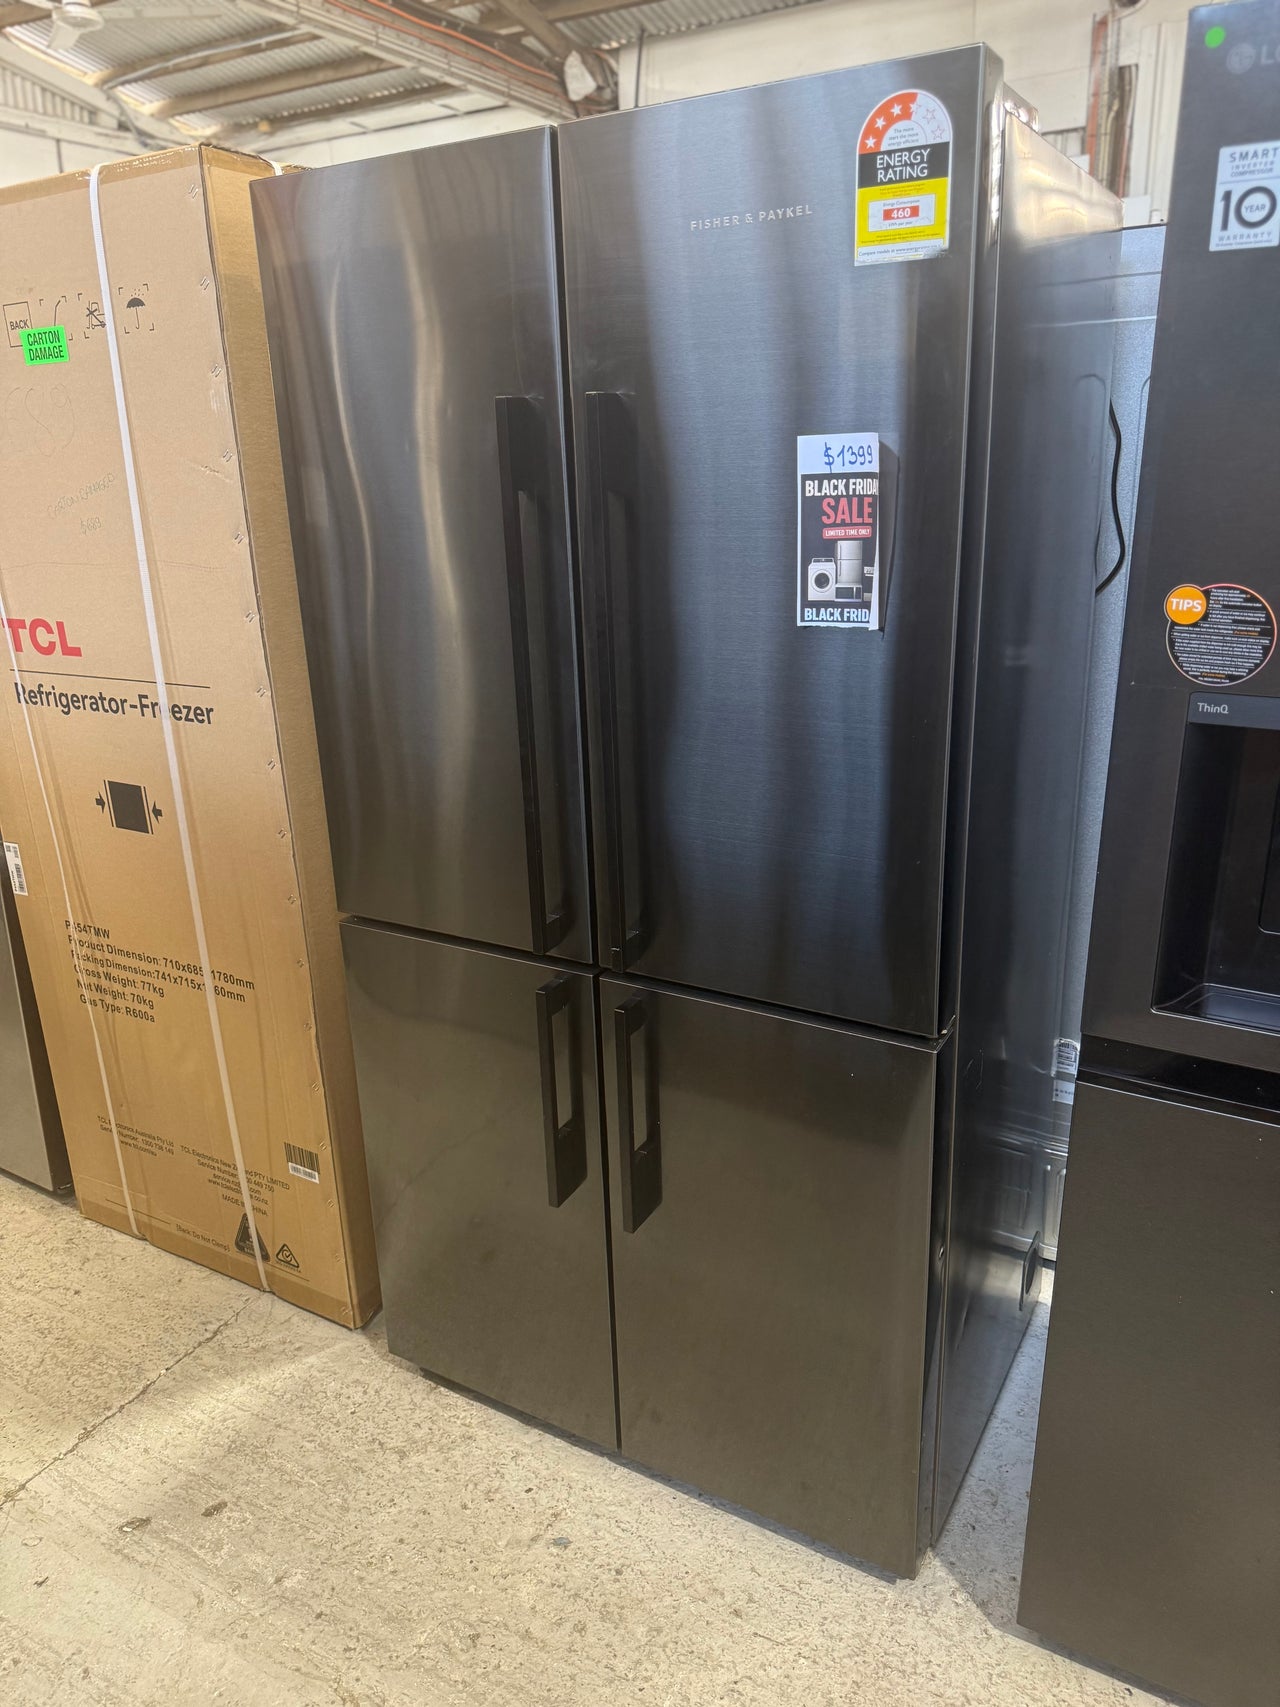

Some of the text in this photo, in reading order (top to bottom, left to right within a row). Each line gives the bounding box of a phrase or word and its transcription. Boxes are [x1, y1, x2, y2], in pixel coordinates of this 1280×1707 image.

[876, 148, 930, 169] ENERGY
[1229, 147, 1279, 164] SMART
[877, 163, 928, 184] RATING
[891, 208, 911, 219] 460
[1220, 186, 1277, 232] 10
[1244, 204, 1266, 214] YEAR
[690, 205, 813, 232] FISHER & PAYKEL
[1218, 231, 1272, 243] WARRANTY
[9, 319, 29, 330] BACK
[27, 330, 61, 347] CARTON
[28, 345, 65, 361] DAMAGE
[823, 442, 873, 473] $1399
[805, 478, 879, 497] BLACK FRIDA
[821, 497, 873, 525] SALE
[825, 529, 845, 537] LIMITED
[858, 528, 870, 536] ONLY
[1171, 598, 1202, 612] TIPS
[804, 608, 871, 622] BLACK FRID
[1, 617, 82, 657] TCL
[14, 682, 214, 725] Refrigerator-Frezer
[1197, 702, 1230, 715] ThinQ
[163, 957, 255, 990] 710x6851780mm
[140, 980, 165, 998] 77kg
[130, 993, 154, 1010] 70kg
[125, 1006, 155, 1023] R600a
[266, 1176, 290, 1190] LIMITED
